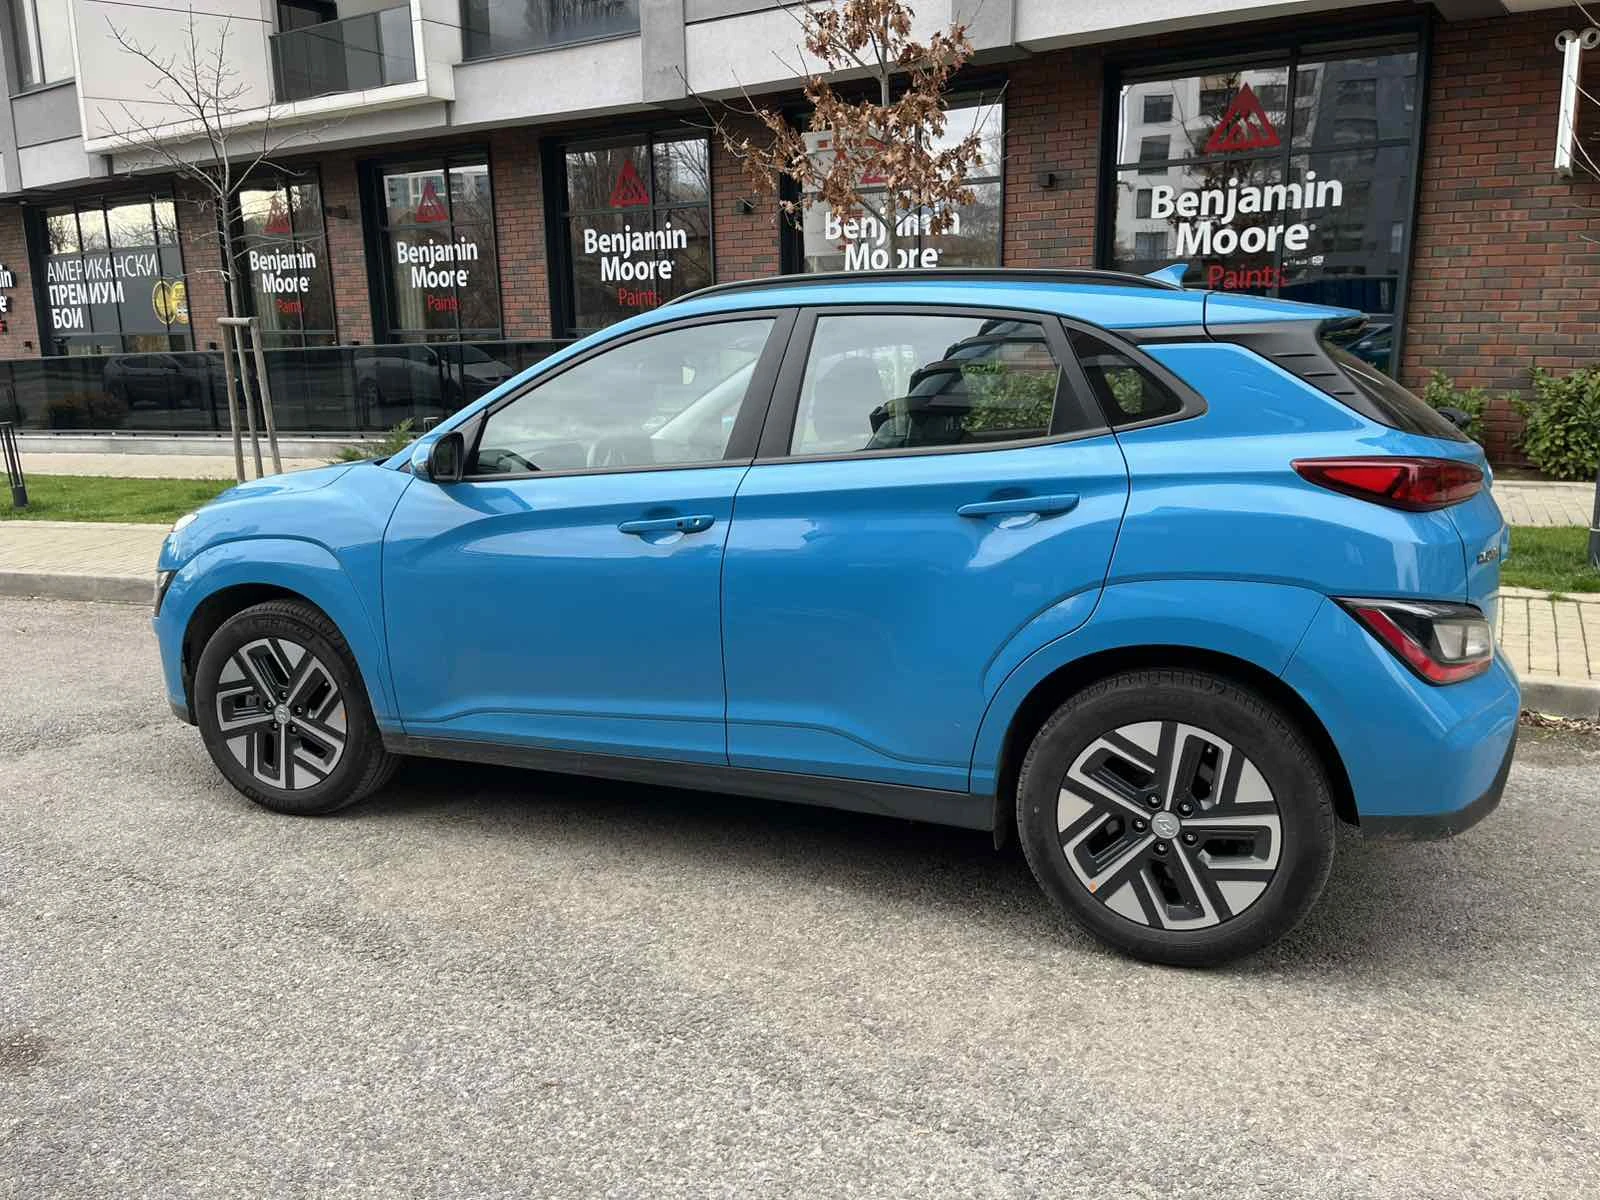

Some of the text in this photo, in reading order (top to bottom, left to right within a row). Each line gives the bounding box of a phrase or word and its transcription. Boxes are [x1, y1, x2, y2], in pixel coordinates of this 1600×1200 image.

[1151, 170, 1343, 225] Benjamin
[397, 236, 478, 269] Benjamin
[584, 221, 688, 259] Benjamin
[1176, 223, 1310, 258] Moore
[47, 253, 159, 283] АМЕРИКАНСКИ
[249, 247, 317, 276] Benjamin
[601, 255, 672, 282] Moore
[262, 272, 309, 294] Moore
[411, 265, 468, 289] Moore
[1207, 264, 1290, 290] Paints
[48, 280, 125, 307] ПРЕМИУМ
[52, 306, 84, 330] БОИ
